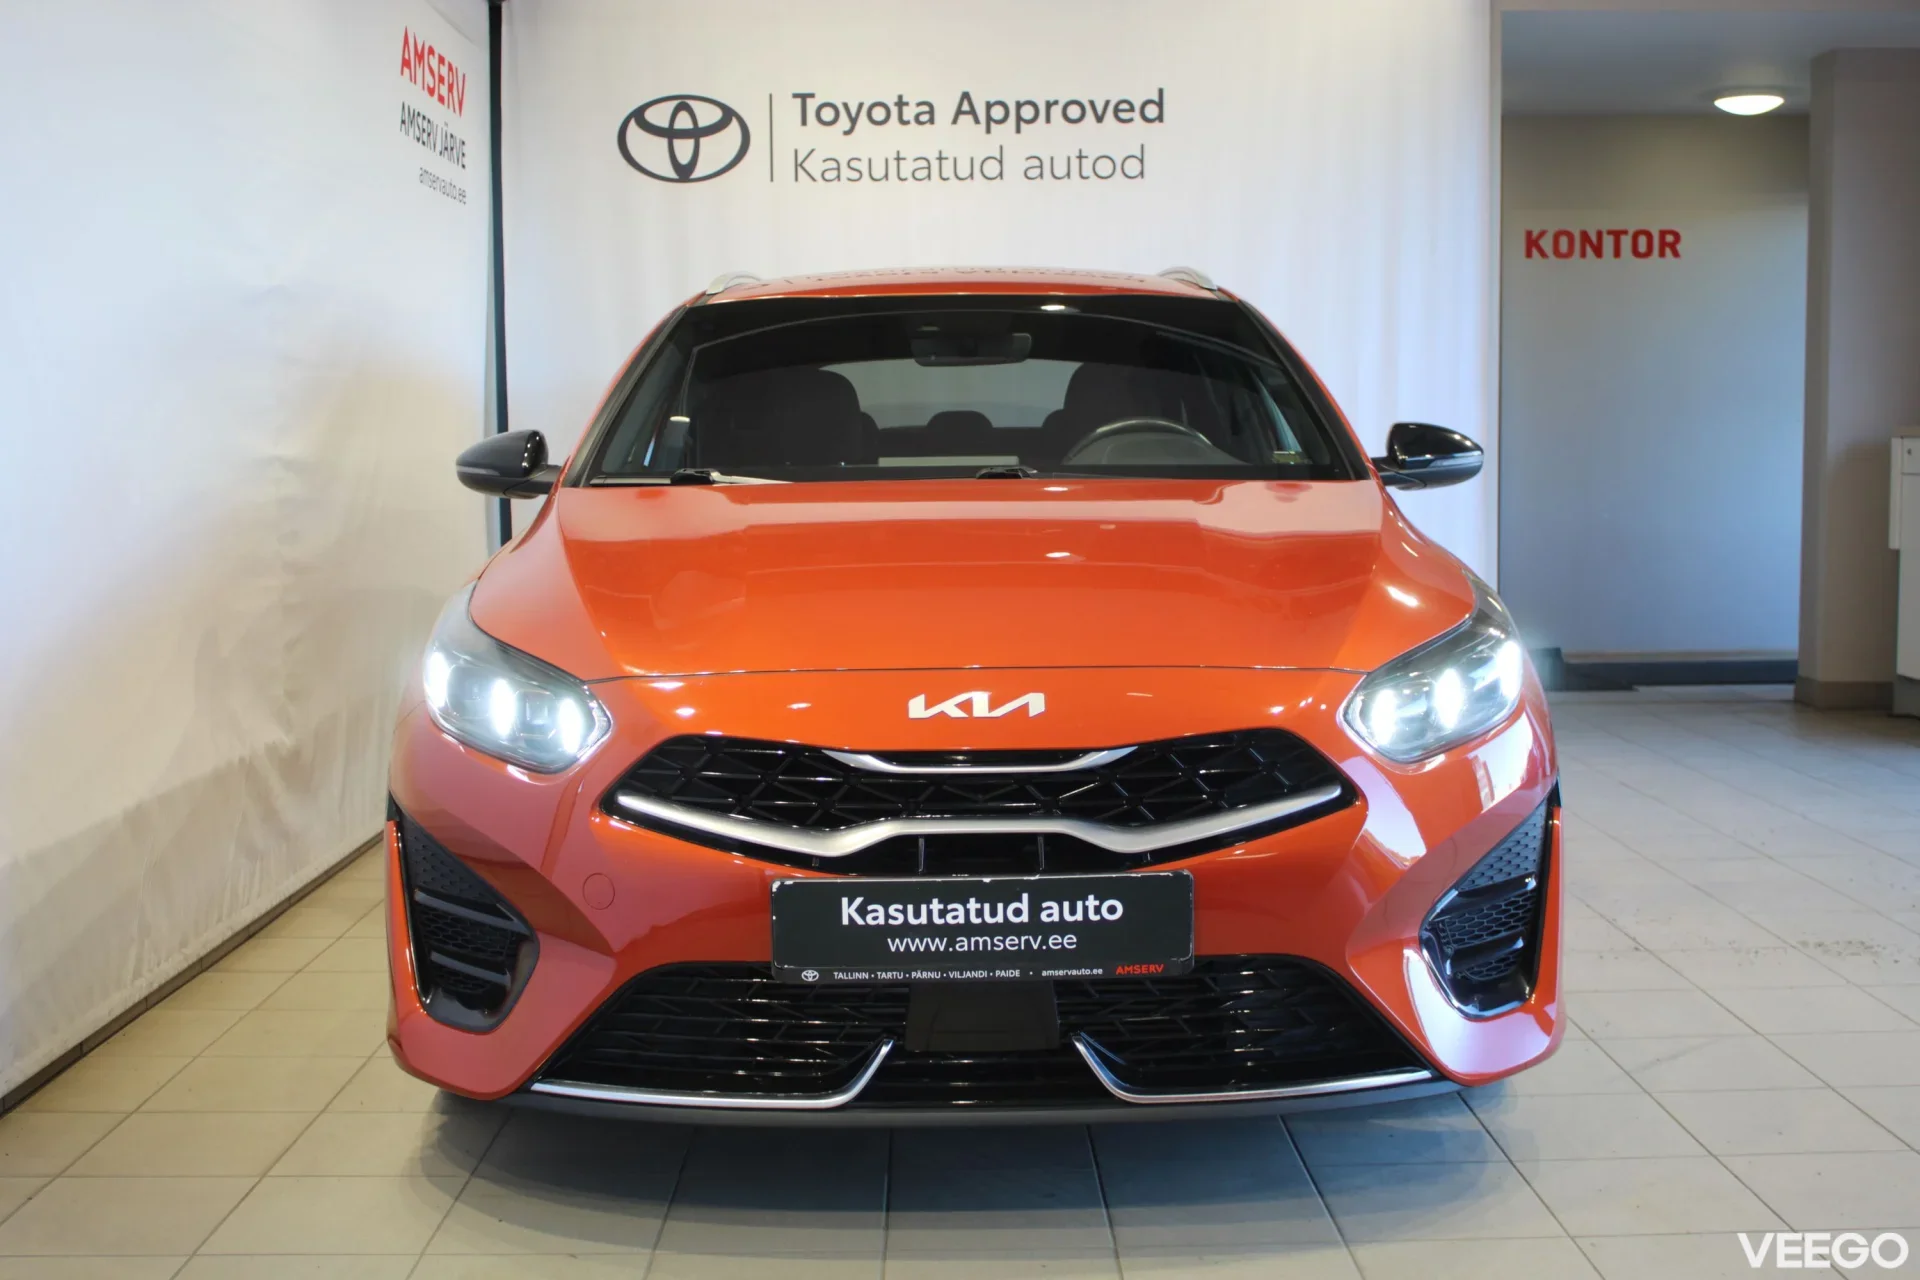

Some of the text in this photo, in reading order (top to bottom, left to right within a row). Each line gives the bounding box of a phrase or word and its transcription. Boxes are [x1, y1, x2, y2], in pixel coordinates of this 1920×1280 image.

[400, 26, 466, 117] AMSERV
[792, 88, 1165, 135] Toyota Approved
[400, 101, 466, 169] AMSERV JÄRVE
[794, 144, 1145, 183] Kasutatud autod
[419, 167, 466, 205] amservauto.ee
[1524, 229, 1682, 259] KONTOR
[841, 893, 1124, 926] Kasutatud auto
[887, 933, 1077, 952] www.amserv.ee
[833, 963, 1164, 980] TALLINN TARTU PÄRNU VILJANDI PAIDE amservauto.ee AMSERV
